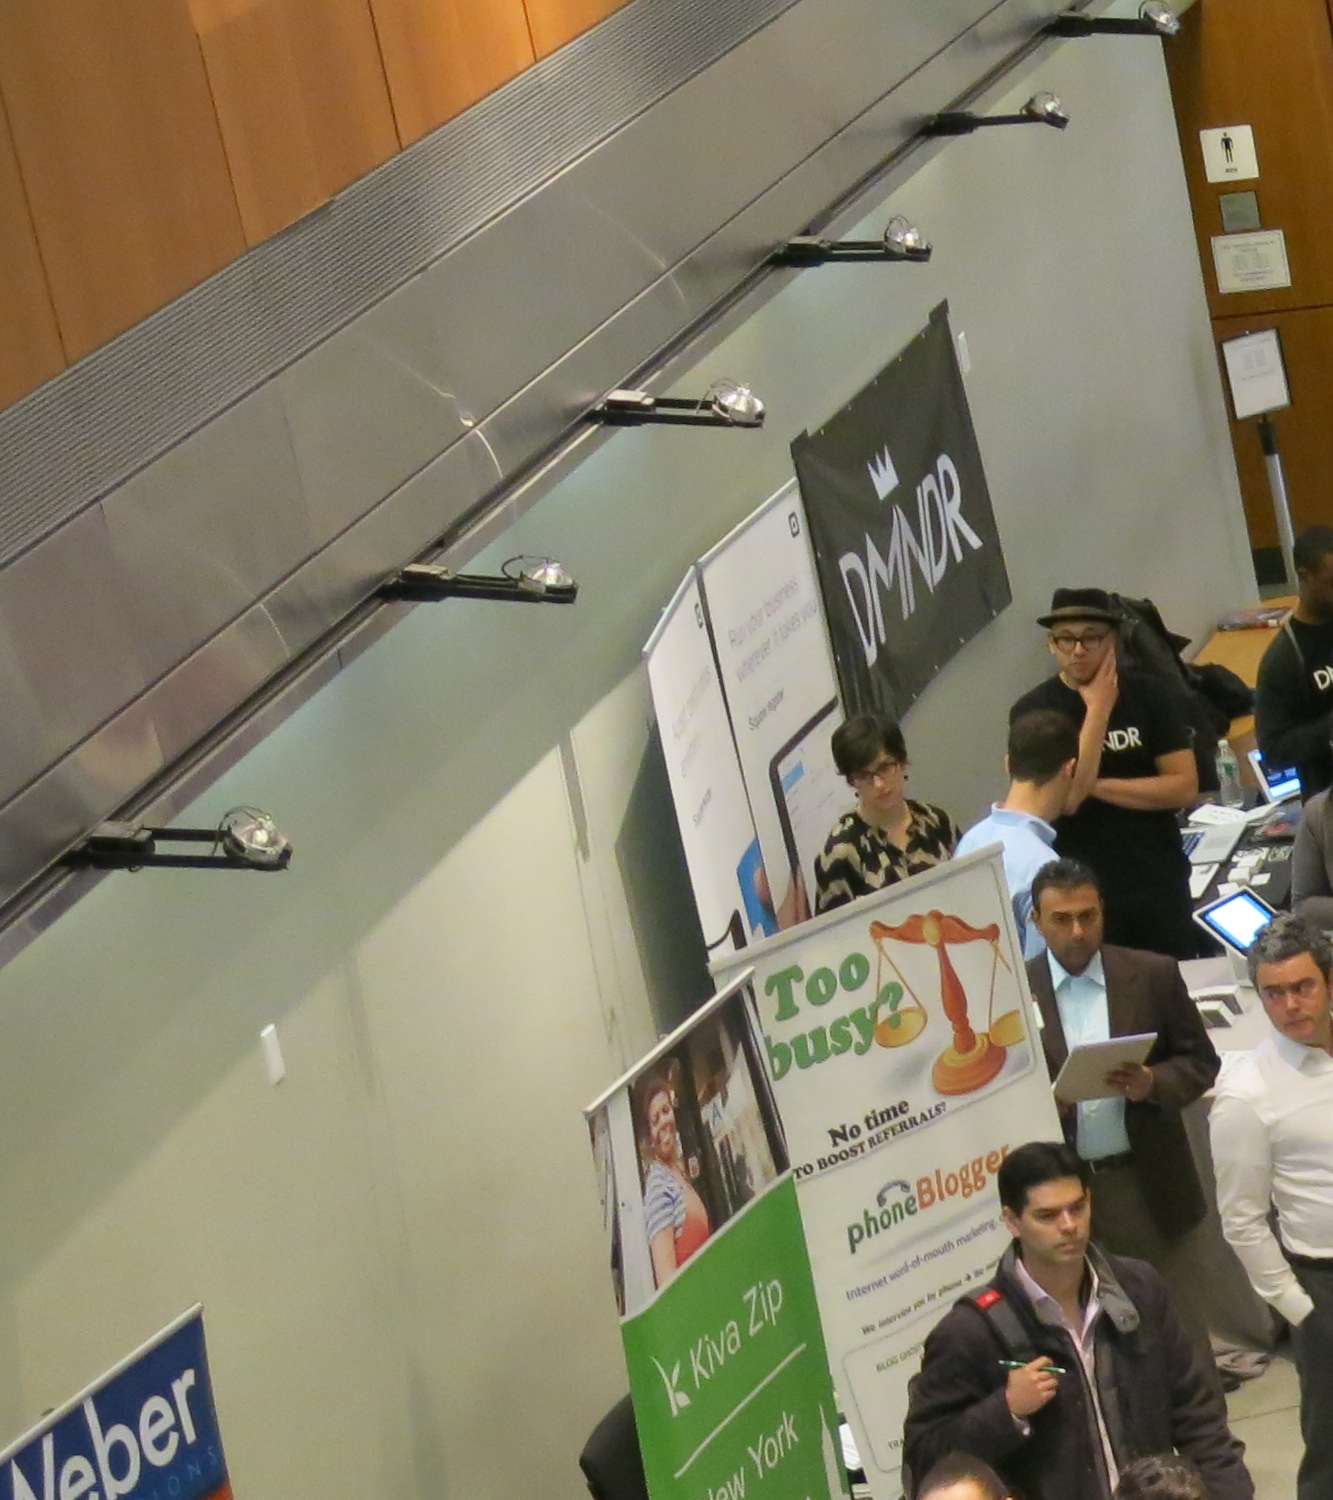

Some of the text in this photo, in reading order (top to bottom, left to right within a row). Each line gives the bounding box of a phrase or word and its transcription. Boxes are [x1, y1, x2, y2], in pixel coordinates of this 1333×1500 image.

[838, 453, 983, 667] DMNDR
[764, 952, 870, 1022] Too
[764, 981, 904, 1082] busy?
[793, 1101, 947, 1180] TO BOOST REFERRALS?
[828, 1100, 910, 1148] No time
[845, 1275, 888, 1301] Internet
[690, 1279, 783, 1388] Kiva Zip
[748, 1410, 798, 1479] York
